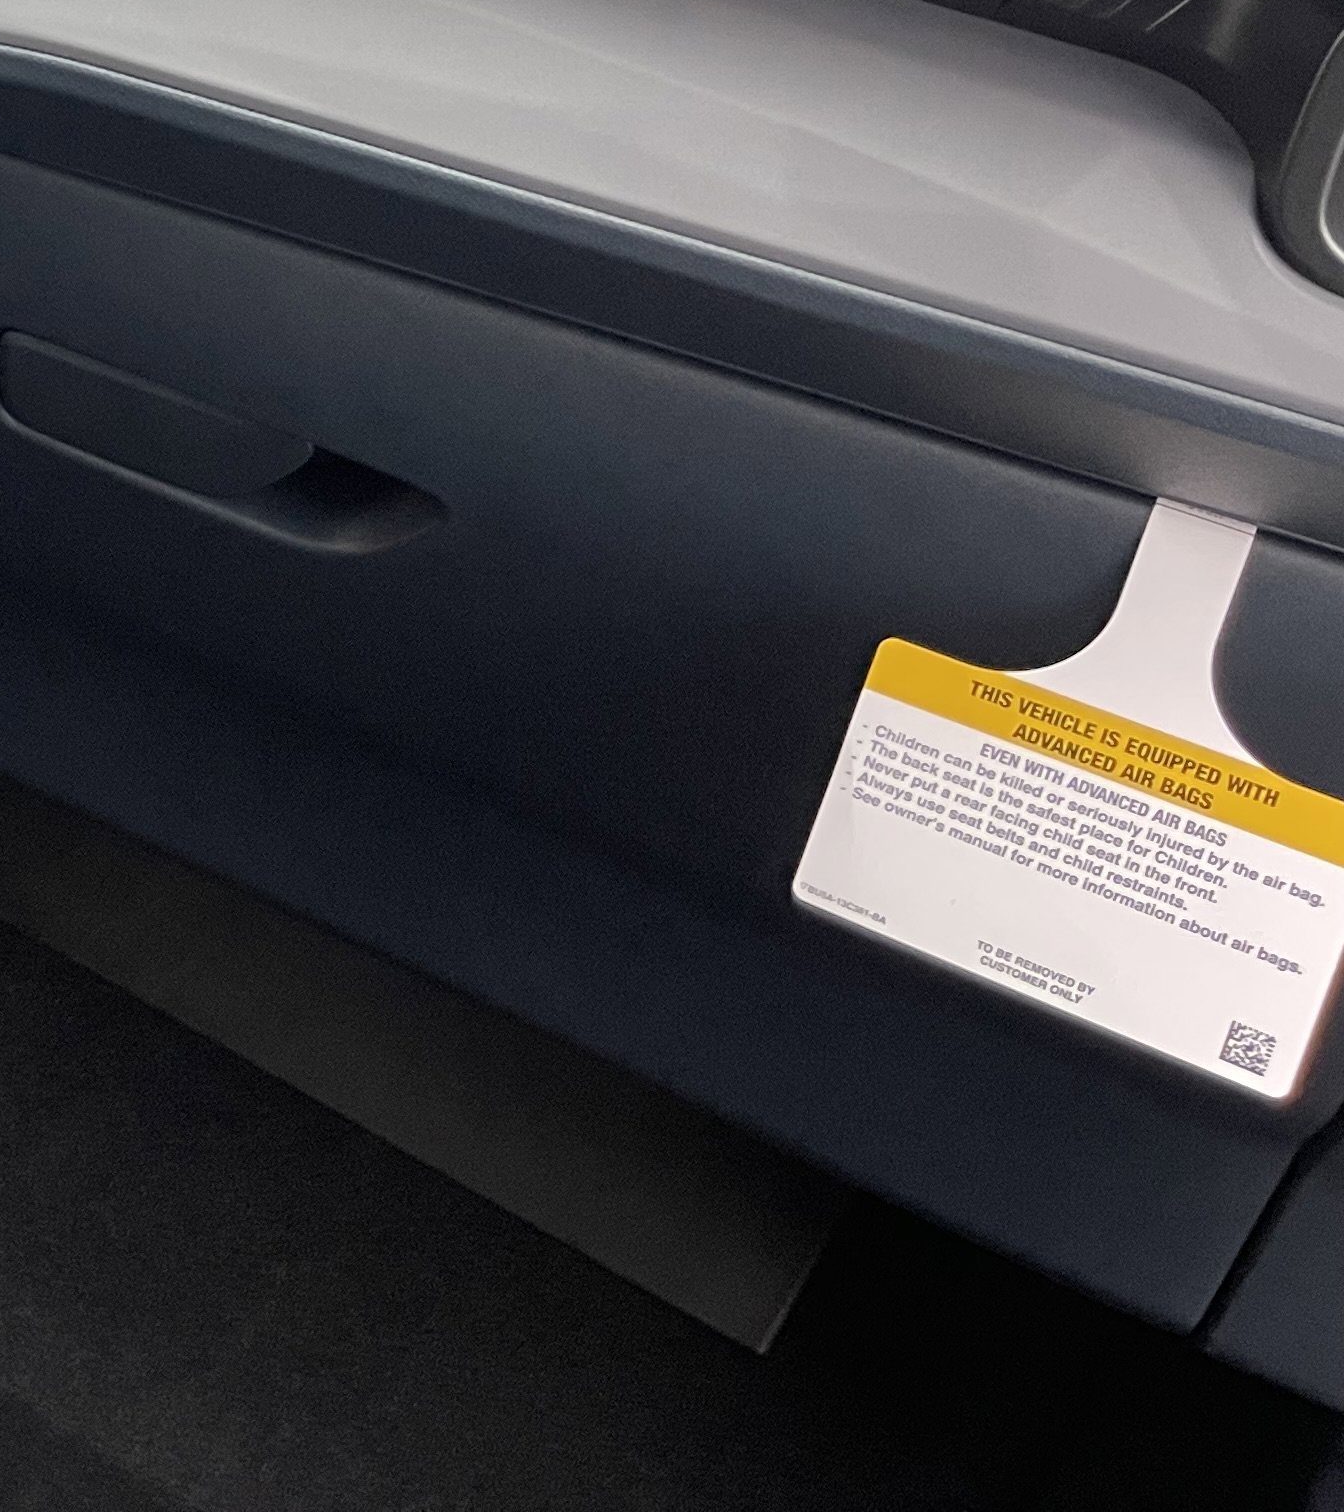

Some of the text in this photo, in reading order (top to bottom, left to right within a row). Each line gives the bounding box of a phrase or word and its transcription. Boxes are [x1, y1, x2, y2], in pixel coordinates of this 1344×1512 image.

[971, 679, 1280, 807] THIS VEHICLE IS EQUIPPED WITH
[979, 742, 1228, 847] EVEN WITH ADVANCED AIR BAGS
[1011, 723, 1213, 809] ADVANCED AIR BAGS
[851, 786, 1302, 975] See owner's manual for more information about air bags.
[855, 771, 1187, 911] Always use seat belts and child restraints.
[862, 754, 1217, 903] Never put a rear facing child seat in the front.
[870, 739, 1227, 888] The back seat is the safest place for Children.
[874, 724, 1325, 907] Children can be killed or seriously injured by the air bag.
[977, 939, 1096, 995] TO BE REMOVED BY
[979, 954, 1083, 1004] CUSTOMER ONLY
